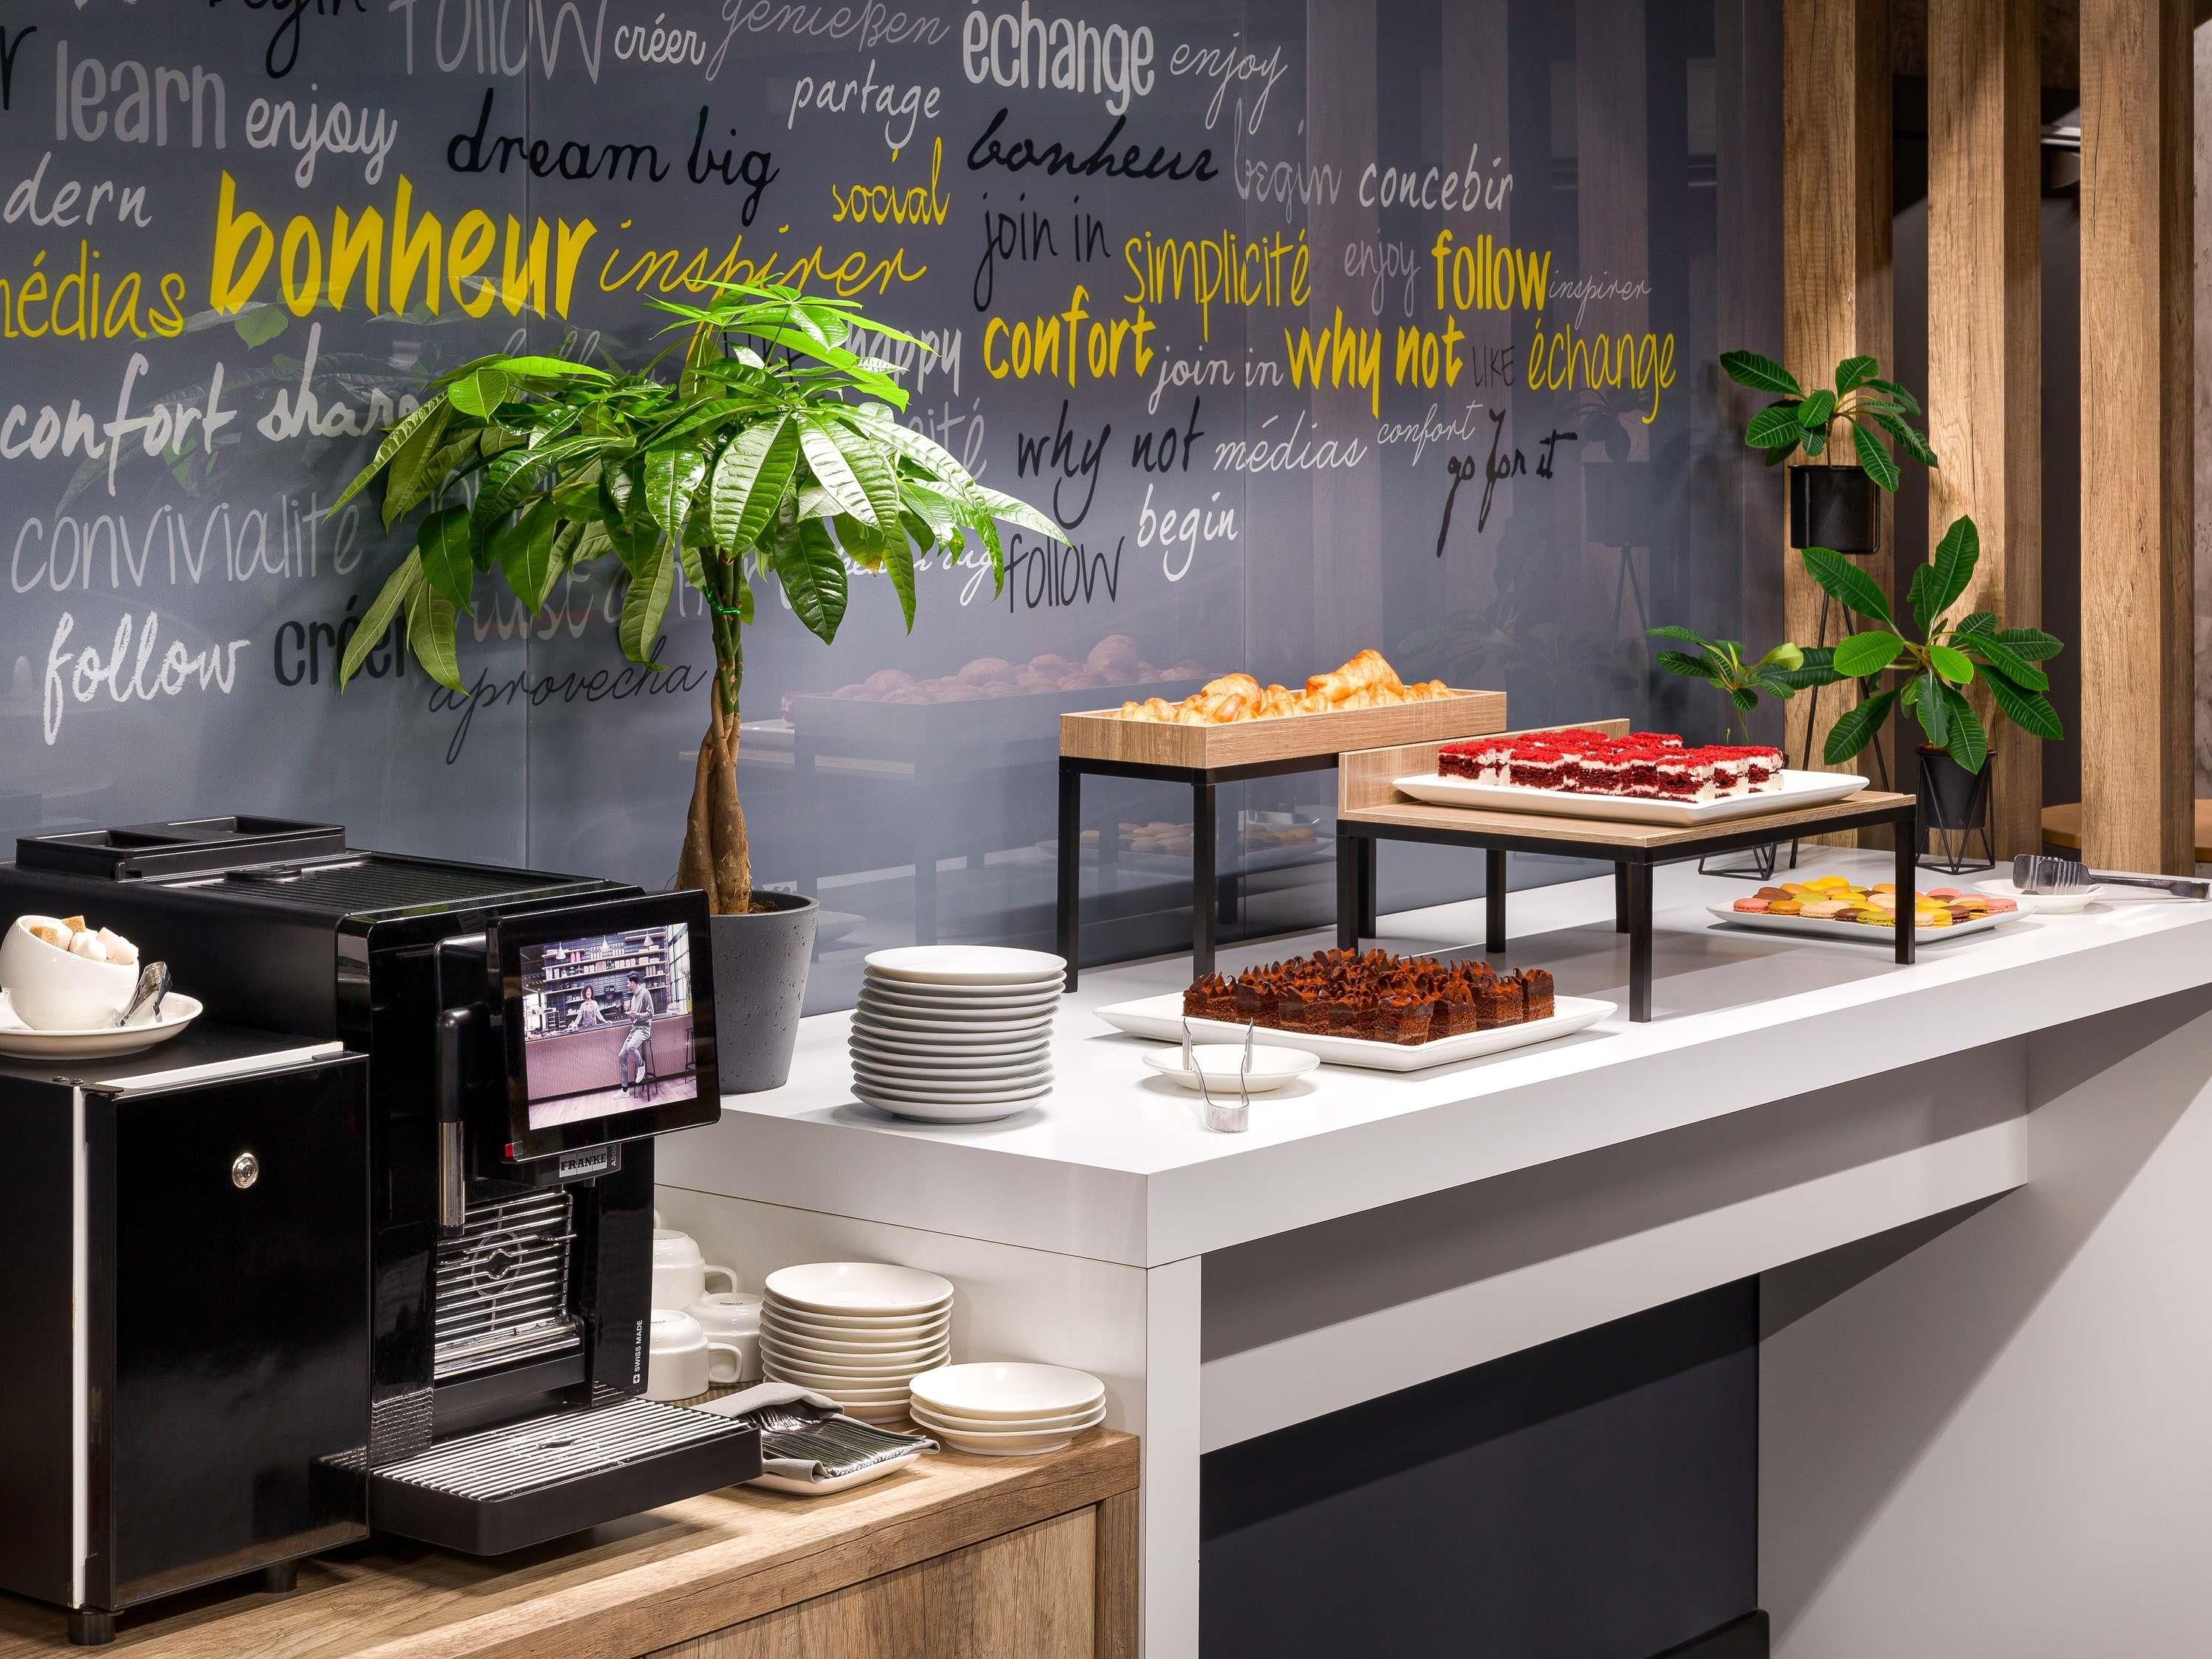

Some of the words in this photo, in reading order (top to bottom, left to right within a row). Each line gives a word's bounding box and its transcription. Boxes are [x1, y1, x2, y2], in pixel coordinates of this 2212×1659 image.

[614, 13, 706, 65] créer
[1170, 32, 1287, 135] enjoy
[55, 40, 225, 149] learn
[246, 83, 397, 188] enjoy
[788, 59, 940, 150] partage
[967, 107, 1218, 181] bonheur
[447, 88, 669, 181] dream
[687, 105, 779, 226] big
[832, 136, 950, 225] social
[1234, 97, 1342, 223] begin
[1358, 143, 1512, 211] concebir
[210, 170, 597, 319] bonheur
[599, 219, 926, 363] inspirer
[973, 192, 1057, 312] join
[1074, 195, 1110, 262] in
[1123, 229, 1311, 341] simplicité
[1344, 229, 1420, 317] enjoy
[1431, 229, 1551, 311] follow
[984, 284, 1156, 389] confort
[1549, 269, 1652, 330] inspirer
[845, 310, 962, 397] happy
[1147, 345, 1235, 415] join
[1245, 347, 1283, 386] in
[1284, 306, 1381, 420] why
[1396, 313, 1466, 389] not
[1472, 344, 1515, 388] LIKE
[1527, 317, 1676, 423] échange
[0, 352, 237, 496] confort
[1018, 400, 1111, 529] why
[1131, 396, 1204, 473] not
[1213, 410, 1367, 473] médias
[1377, 400, 1484, 466] confort
[1136, 484, 1238, 581] begin
[1436, 454, 1475, 558] go
[1478, 408, 1526, 534] for
[1536, 429, 1578, 479] it
[1004, 533, 1124, 613] follow
[44, 612, 251, 745] follow
[425, 635, 707, 765] aprovecha
[560, 1153, 606, 1171] FRANKE
